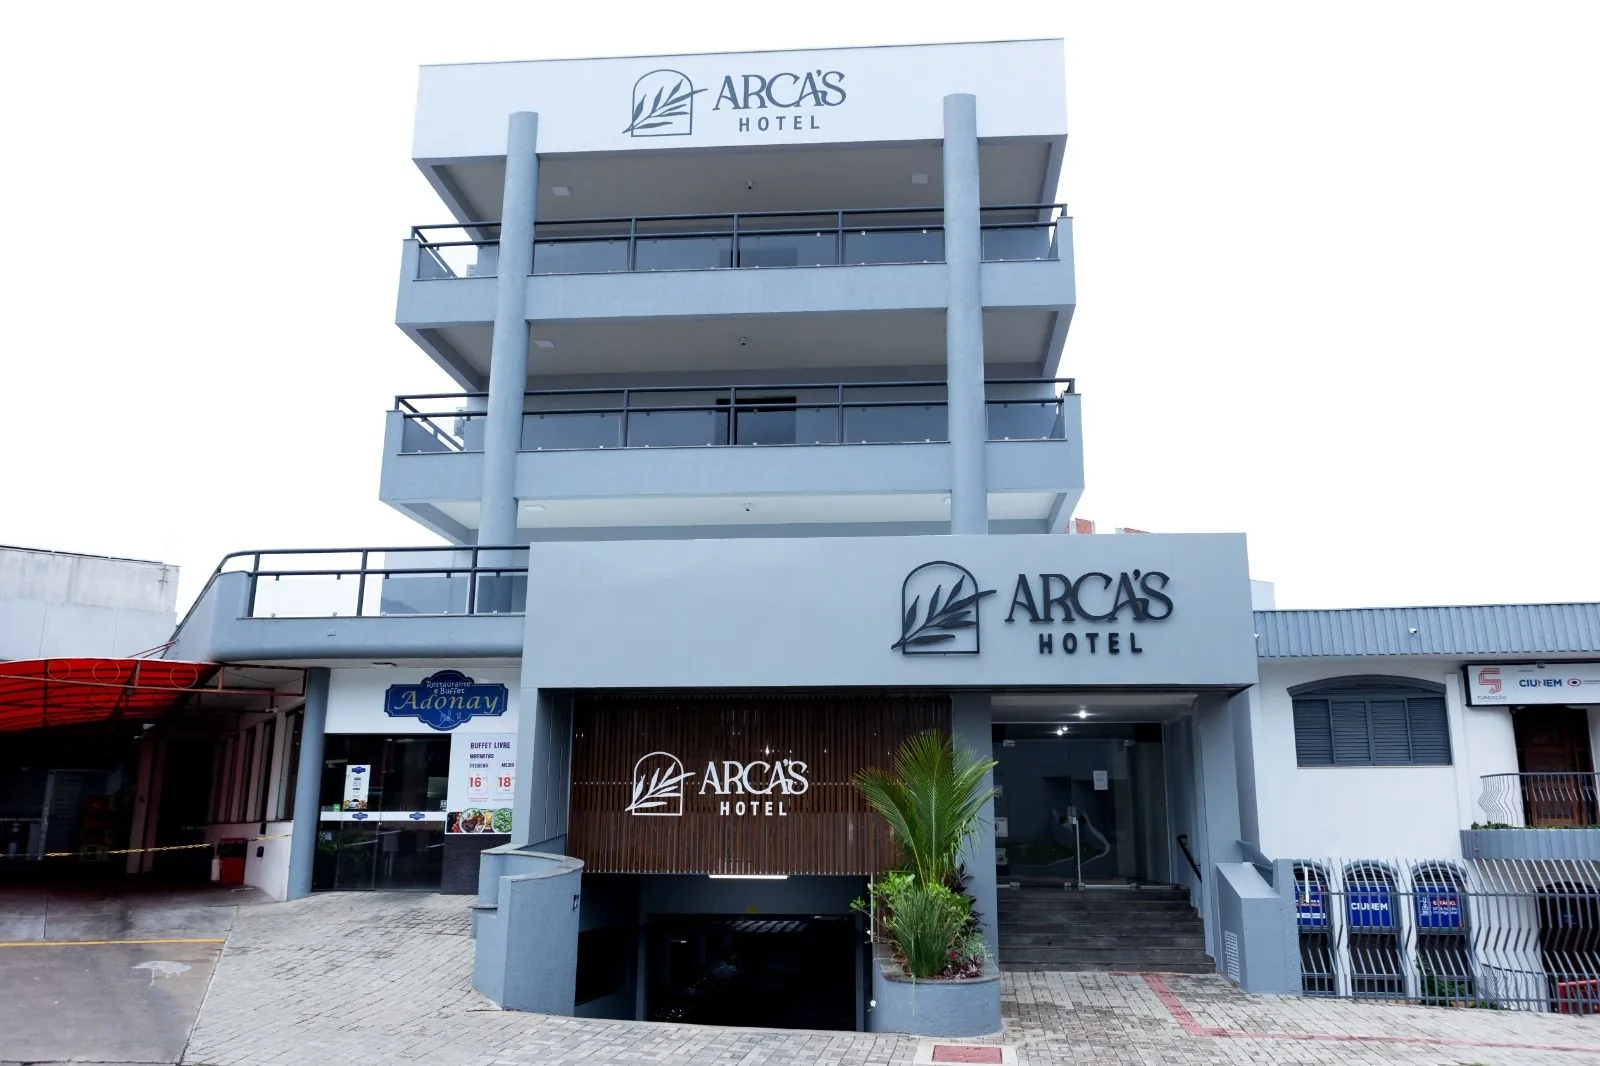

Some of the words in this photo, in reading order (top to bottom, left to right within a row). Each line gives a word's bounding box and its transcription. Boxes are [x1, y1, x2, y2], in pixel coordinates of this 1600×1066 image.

[712, 70, 847, 111] ARCA'S
[739, 115, 821, 132] HOTEL
[1004, 568, 1174, 623] ARCA'S
[1039, 632, 1143, 654] HOTEL
[427, 681, 472, 689] Restaurante
[440, 687, 465, 695] Buffet
[394, 690, 499, 715] Adonay
[494, 741, 511, 749] LIVRE
[469, 777, 481, 787] 16
[498, 777, 511, 787] 18
[699, 758, 809, 795] ARCA'S
[720, 801, 787, 816] HOTEL
